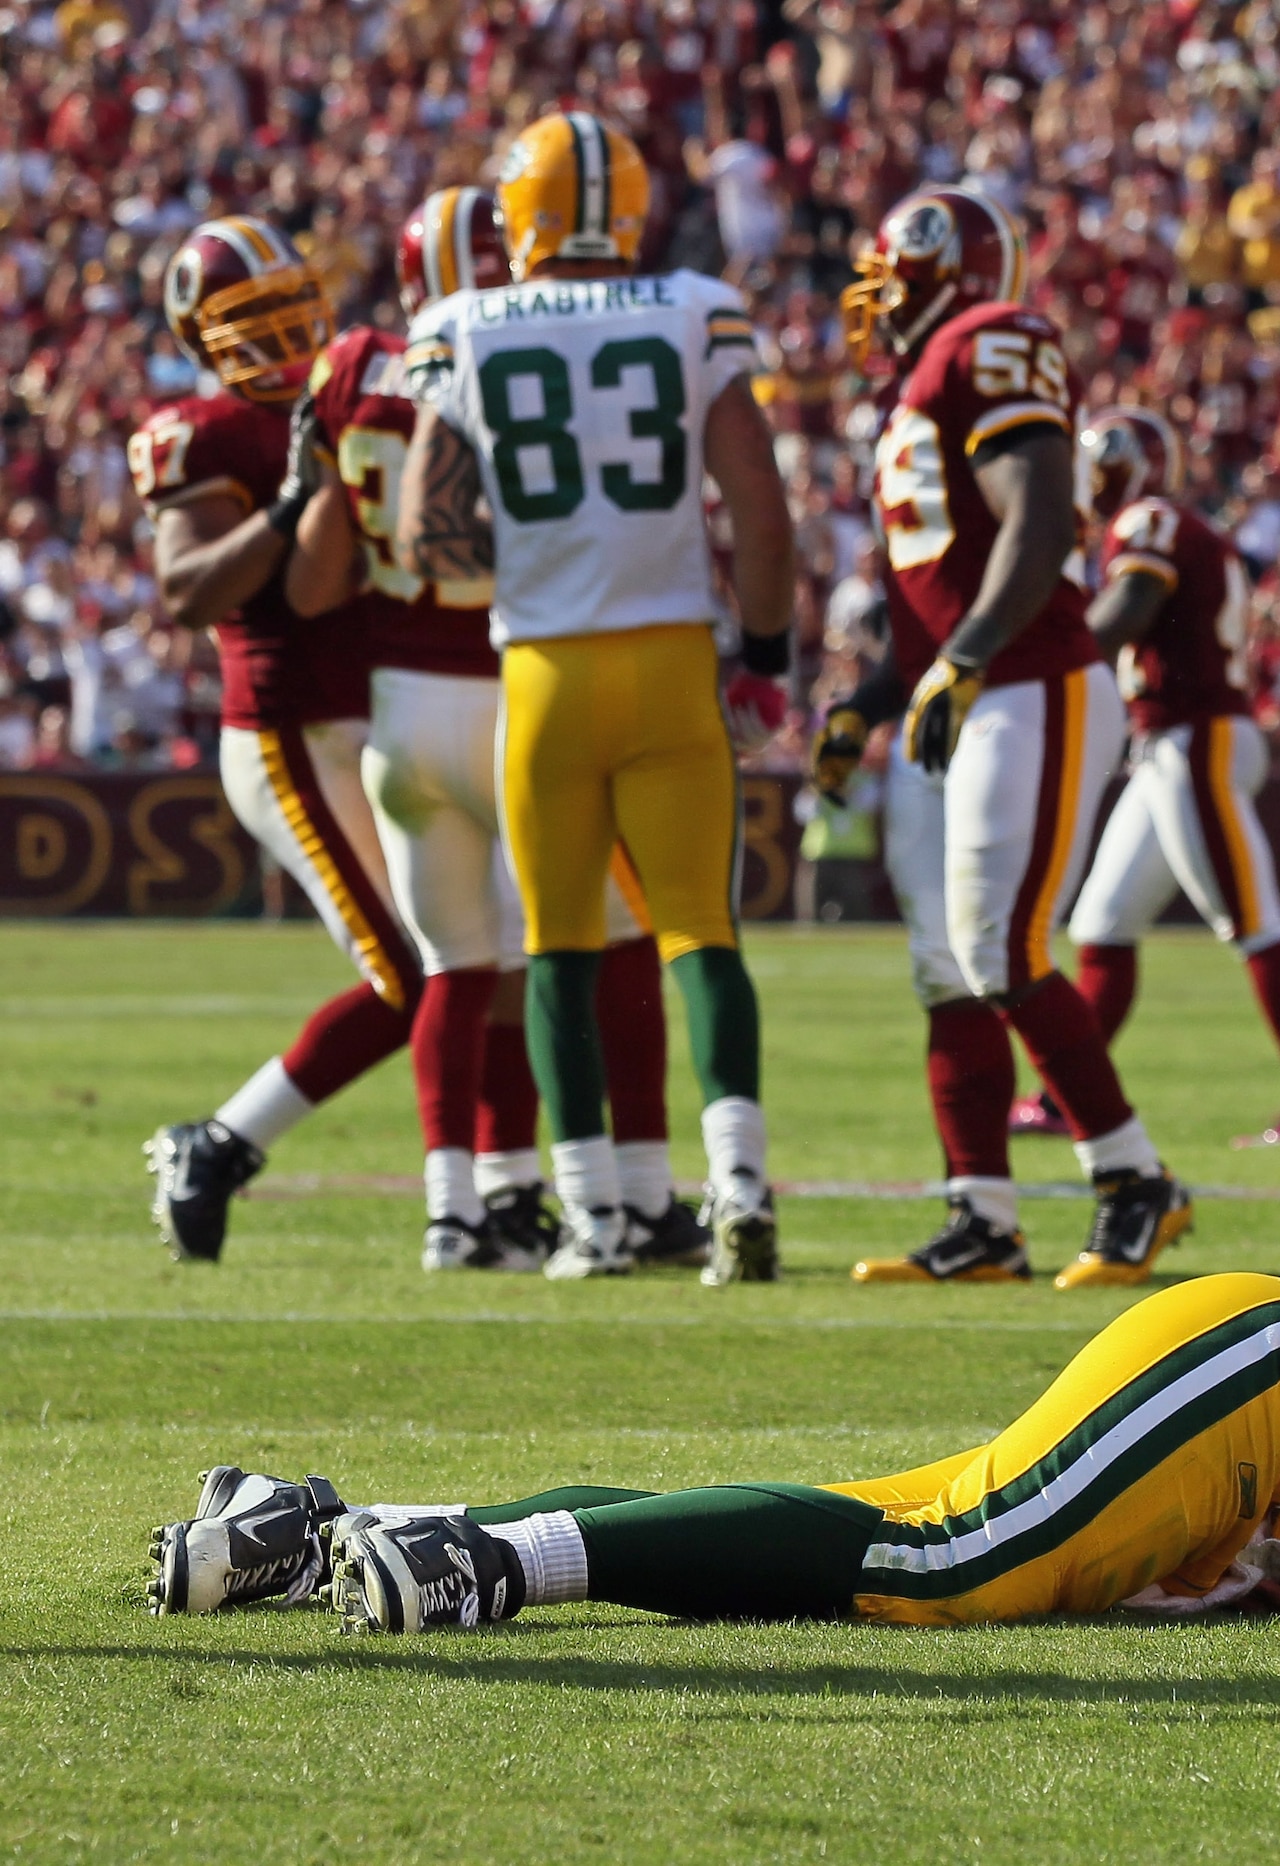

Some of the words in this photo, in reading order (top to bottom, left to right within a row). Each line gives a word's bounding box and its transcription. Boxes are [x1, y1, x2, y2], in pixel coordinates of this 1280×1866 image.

[127, 421, 194, 497] 97
[337, 422, 496, 610] 3
[480, 336, 686, 524] 83
